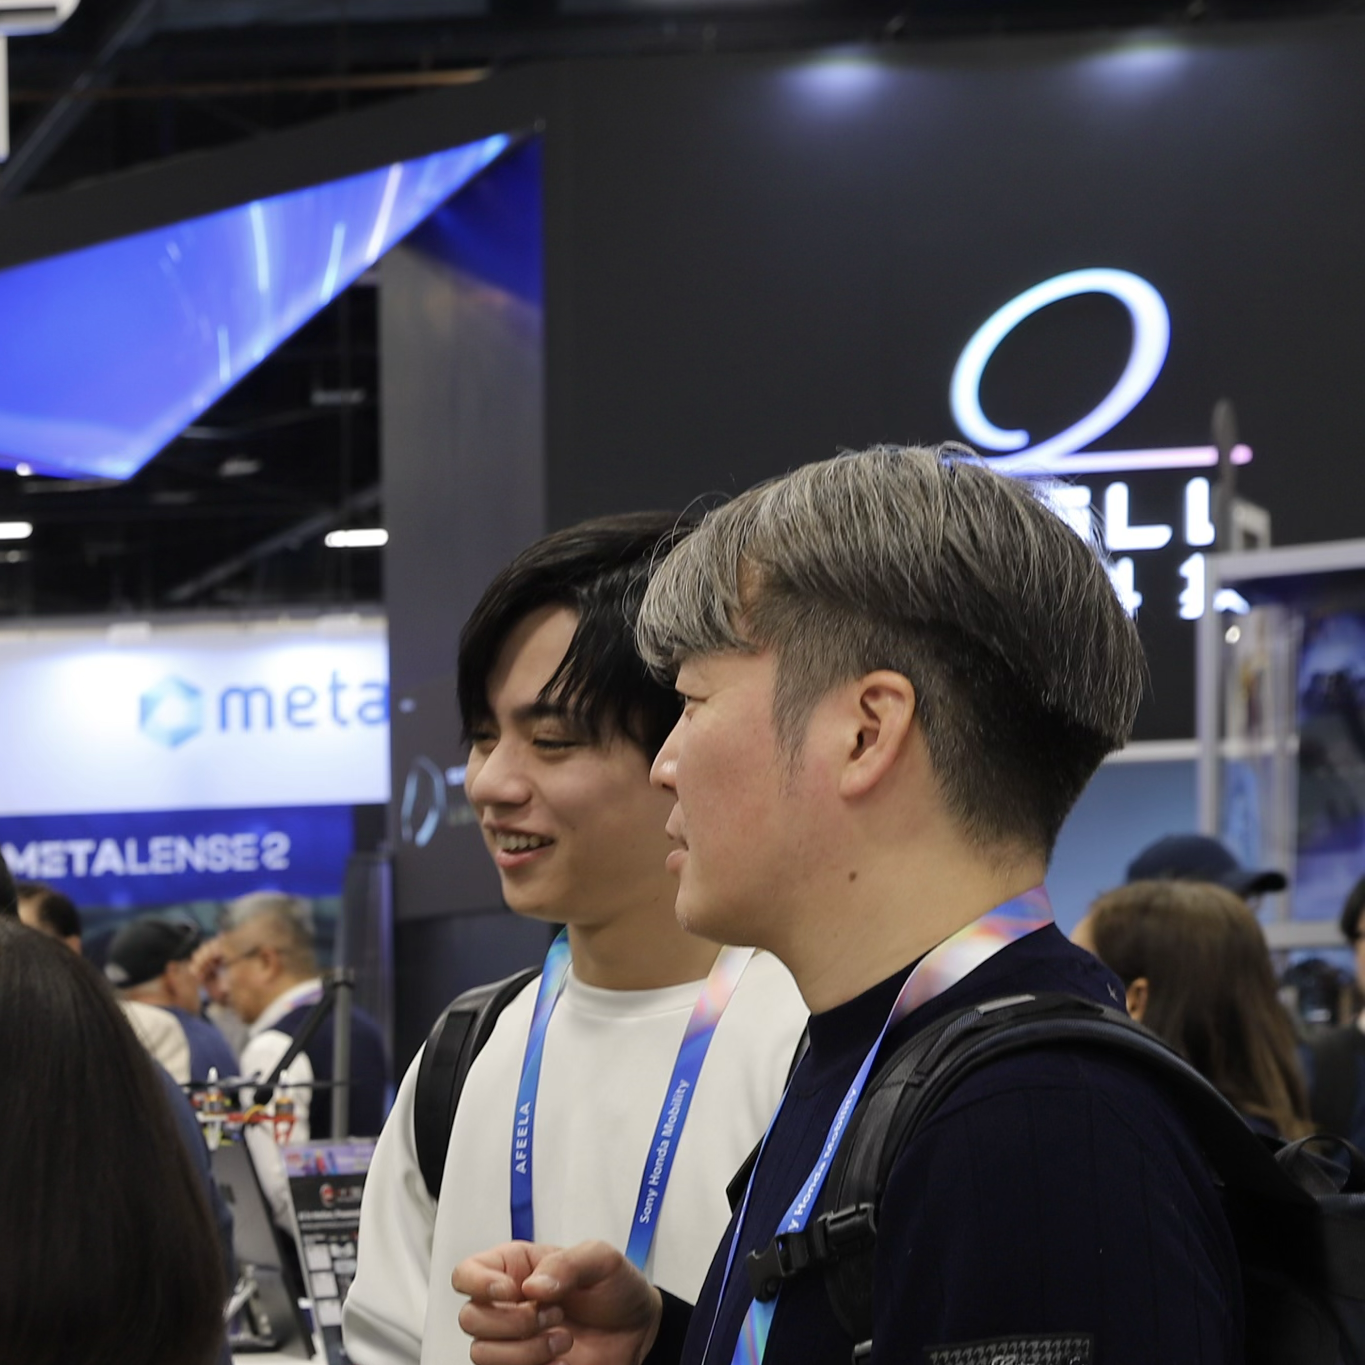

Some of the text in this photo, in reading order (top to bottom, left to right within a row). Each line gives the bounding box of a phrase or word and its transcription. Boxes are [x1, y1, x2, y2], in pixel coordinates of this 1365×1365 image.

[2, 831, 290, 880] METALENSE 2
[515, 1101, 532, 1175] AFEELA
[639, 1078, 690, 1224] Sony Honda Mobility
[794, 1161, 827, 1216] Honda
